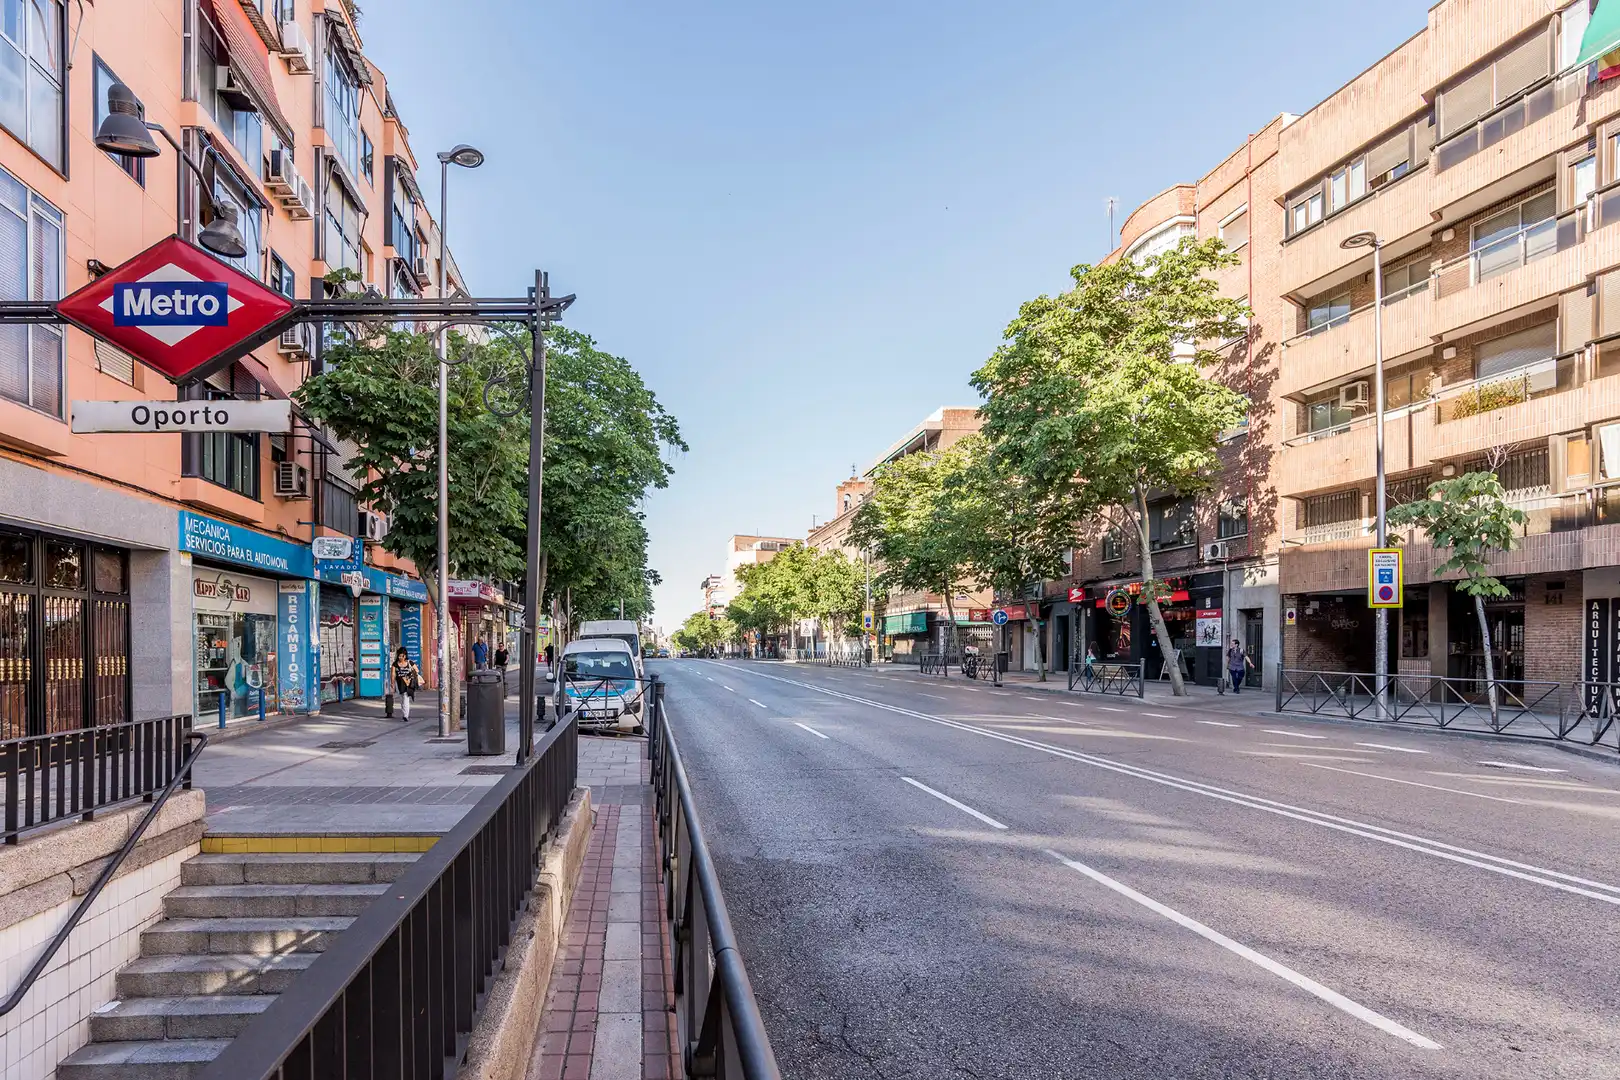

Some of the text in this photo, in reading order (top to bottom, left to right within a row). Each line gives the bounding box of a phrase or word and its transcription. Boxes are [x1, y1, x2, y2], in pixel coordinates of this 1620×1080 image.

[123, 289, 220, 316] Metro
[131, 405, 229, 429] Oporto
[186, 517, 230, 542] MECÁNICA
[186, 534, 225, 555] SERVICIOS
[227, 545, 245, 560] PARA
[246, 549, 253, 562] EL
[287, 595, 299, 682] RECAMBIOS
[1591, 602, 1600, 714] ARQUITECTURA
